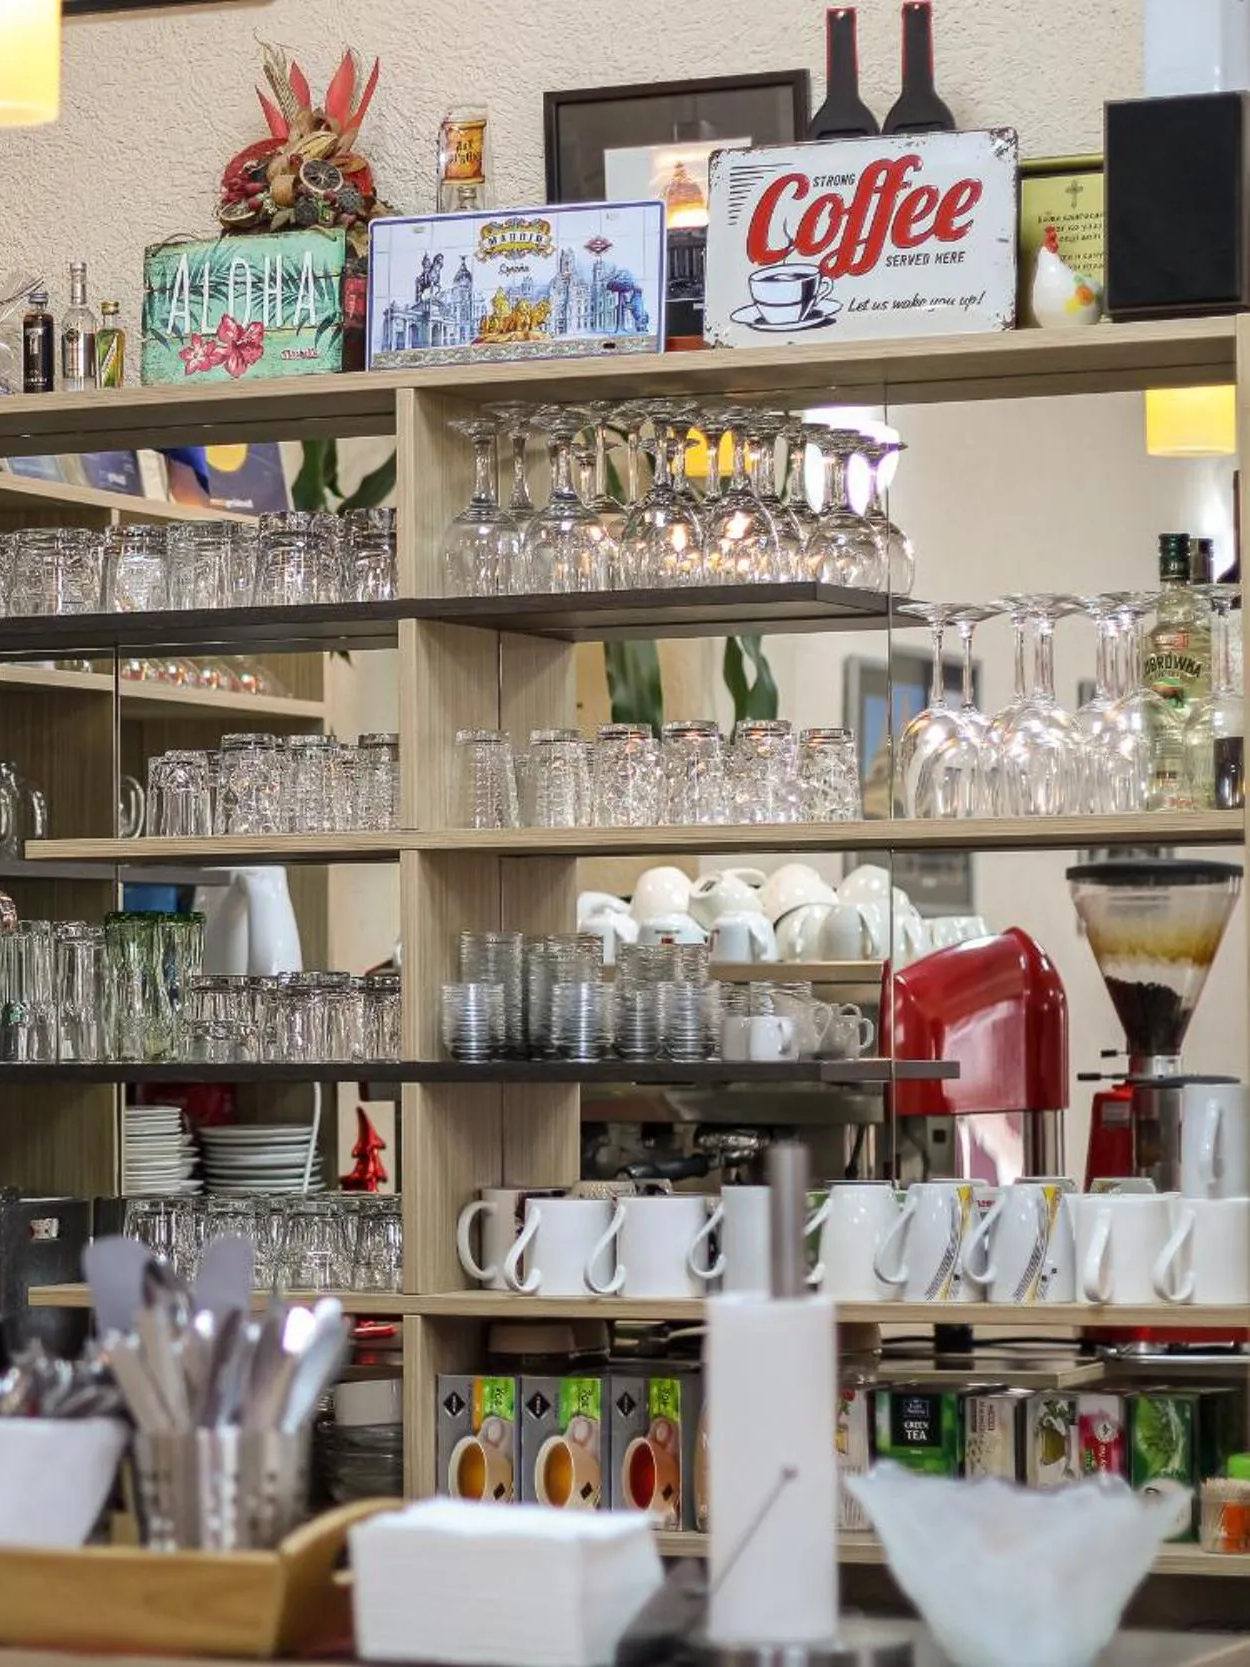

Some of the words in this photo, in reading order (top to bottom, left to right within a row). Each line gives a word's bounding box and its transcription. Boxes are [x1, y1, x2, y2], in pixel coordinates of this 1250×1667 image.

[812, 174, 856, 188] STRONG
[746, 154, 984, 280] Coffee
[885, 254, 930, 268] SERVED
[934, 251, 966, 265] HERE
[166, 251, 318, 335] ALOHA
[848, 297, 870, 312] Let
[872, 299, 888, 311] us
[892, 292, 926, 311] wake
[928, 295, 955, 313] you
[959, 291, 986, 312] up!
[905, 1430, 928, 1441] TEA
